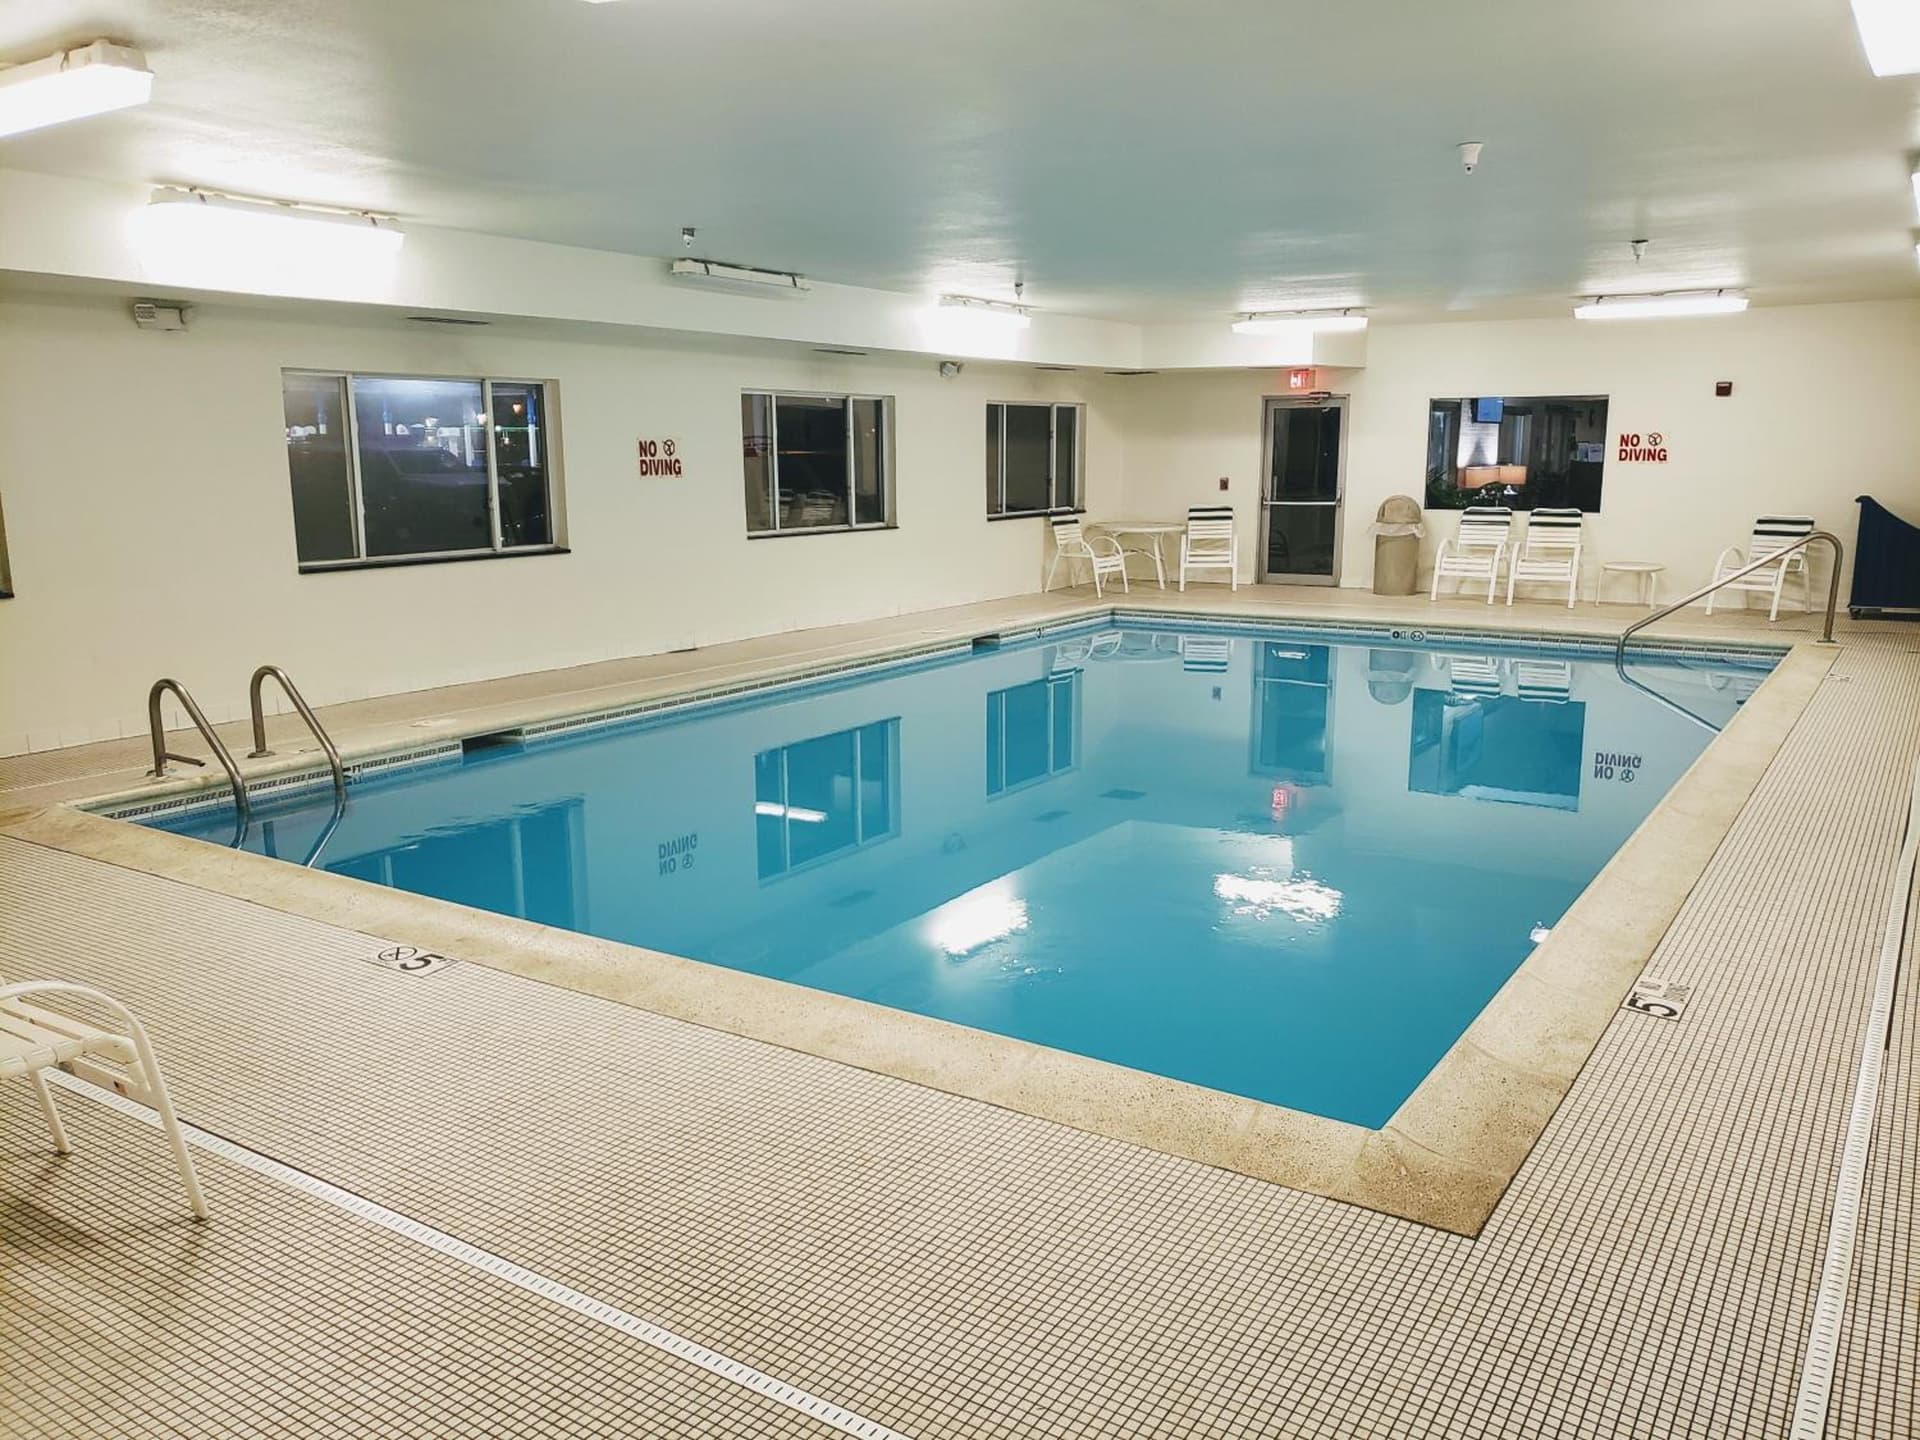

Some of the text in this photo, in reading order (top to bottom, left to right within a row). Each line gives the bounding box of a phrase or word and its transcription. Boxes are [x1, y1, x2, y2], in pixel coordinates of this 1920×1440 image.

[638, 439, 658, 458] NO
[1619, 433, 1641, 448] NO
[1618, 447, 1668, 462] DIVING
[639, 458, 682, 476] DIVING
[399, 953, 444, 971] 5
[1626, 997, 1679, 1018] 5
